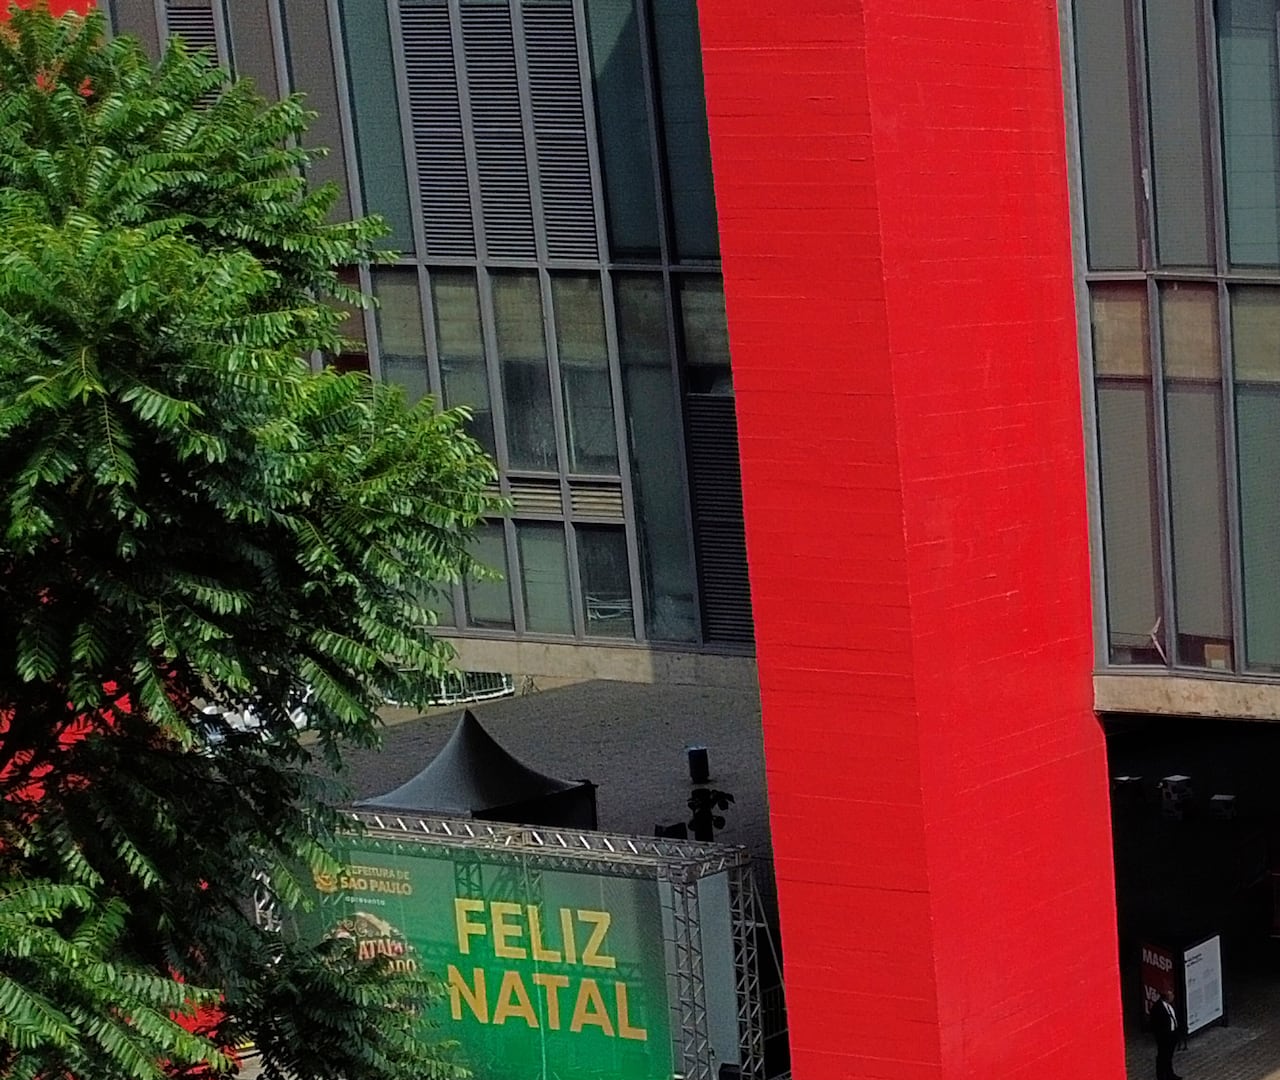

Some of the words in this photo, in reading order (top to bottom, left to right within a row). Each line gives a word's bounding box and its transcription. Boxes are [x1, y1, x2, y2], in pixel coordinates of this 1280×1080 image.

[369, 880, 412, 895] PAULO
[454, 897, 617, 969] FELIZ
[1142, 948, 1173, 972] MASP
[446, 963, 648, 1041] NATAL
